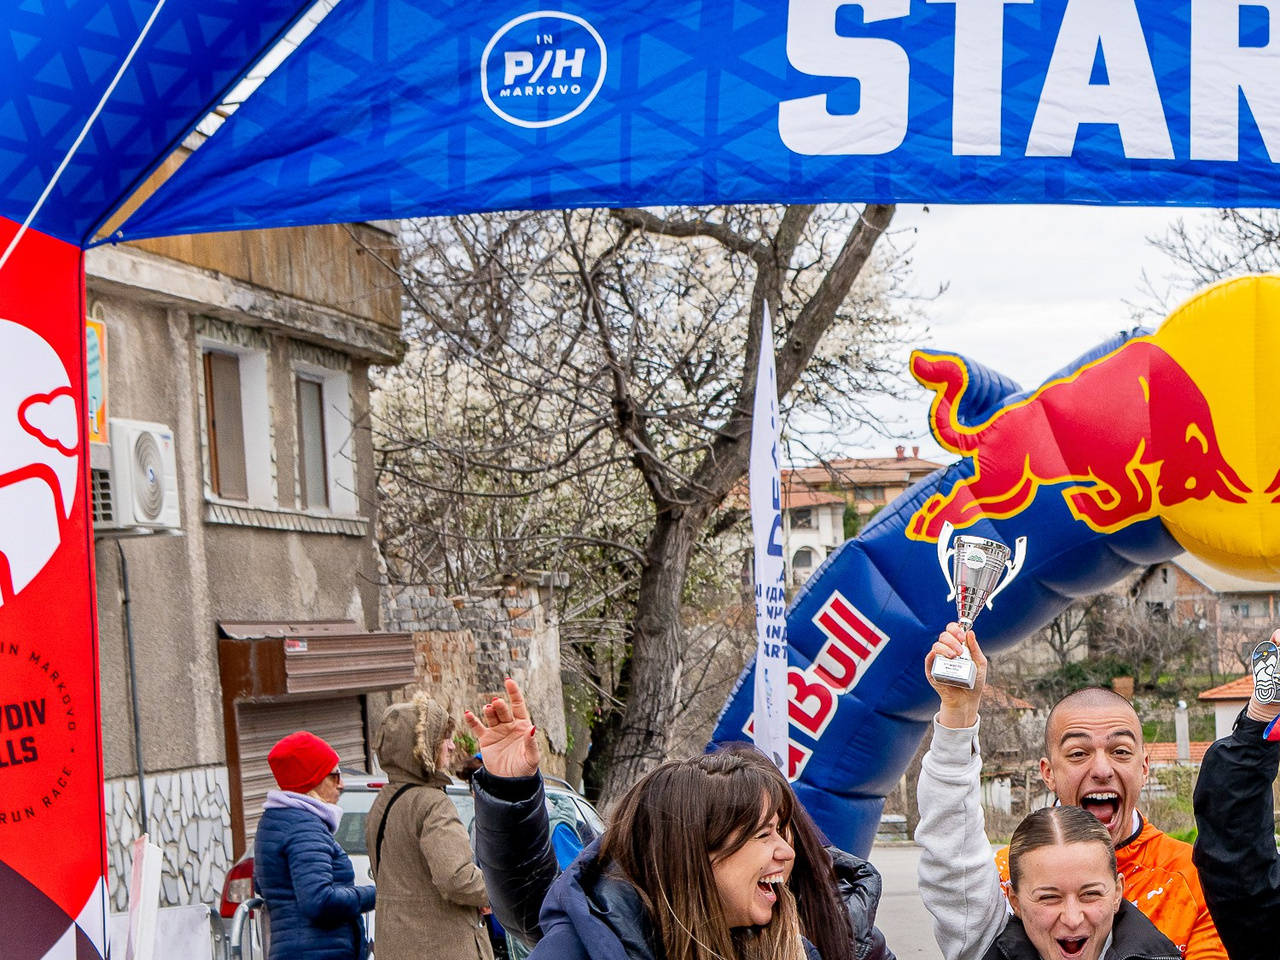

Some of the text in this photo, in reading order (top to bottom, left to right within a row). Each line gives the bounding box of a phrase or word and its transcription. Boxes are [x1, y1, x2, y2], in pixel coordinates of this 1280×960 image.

[536, 33, 553, 46] IN
[502, 47, 586, 87] P/H
[499, 83, 582, 98] MARKOVO
[28, 651, 76, 731] MARKOVO
[0, 698, 46, 733] DIV
[42, 766, 73, 808] RACE
